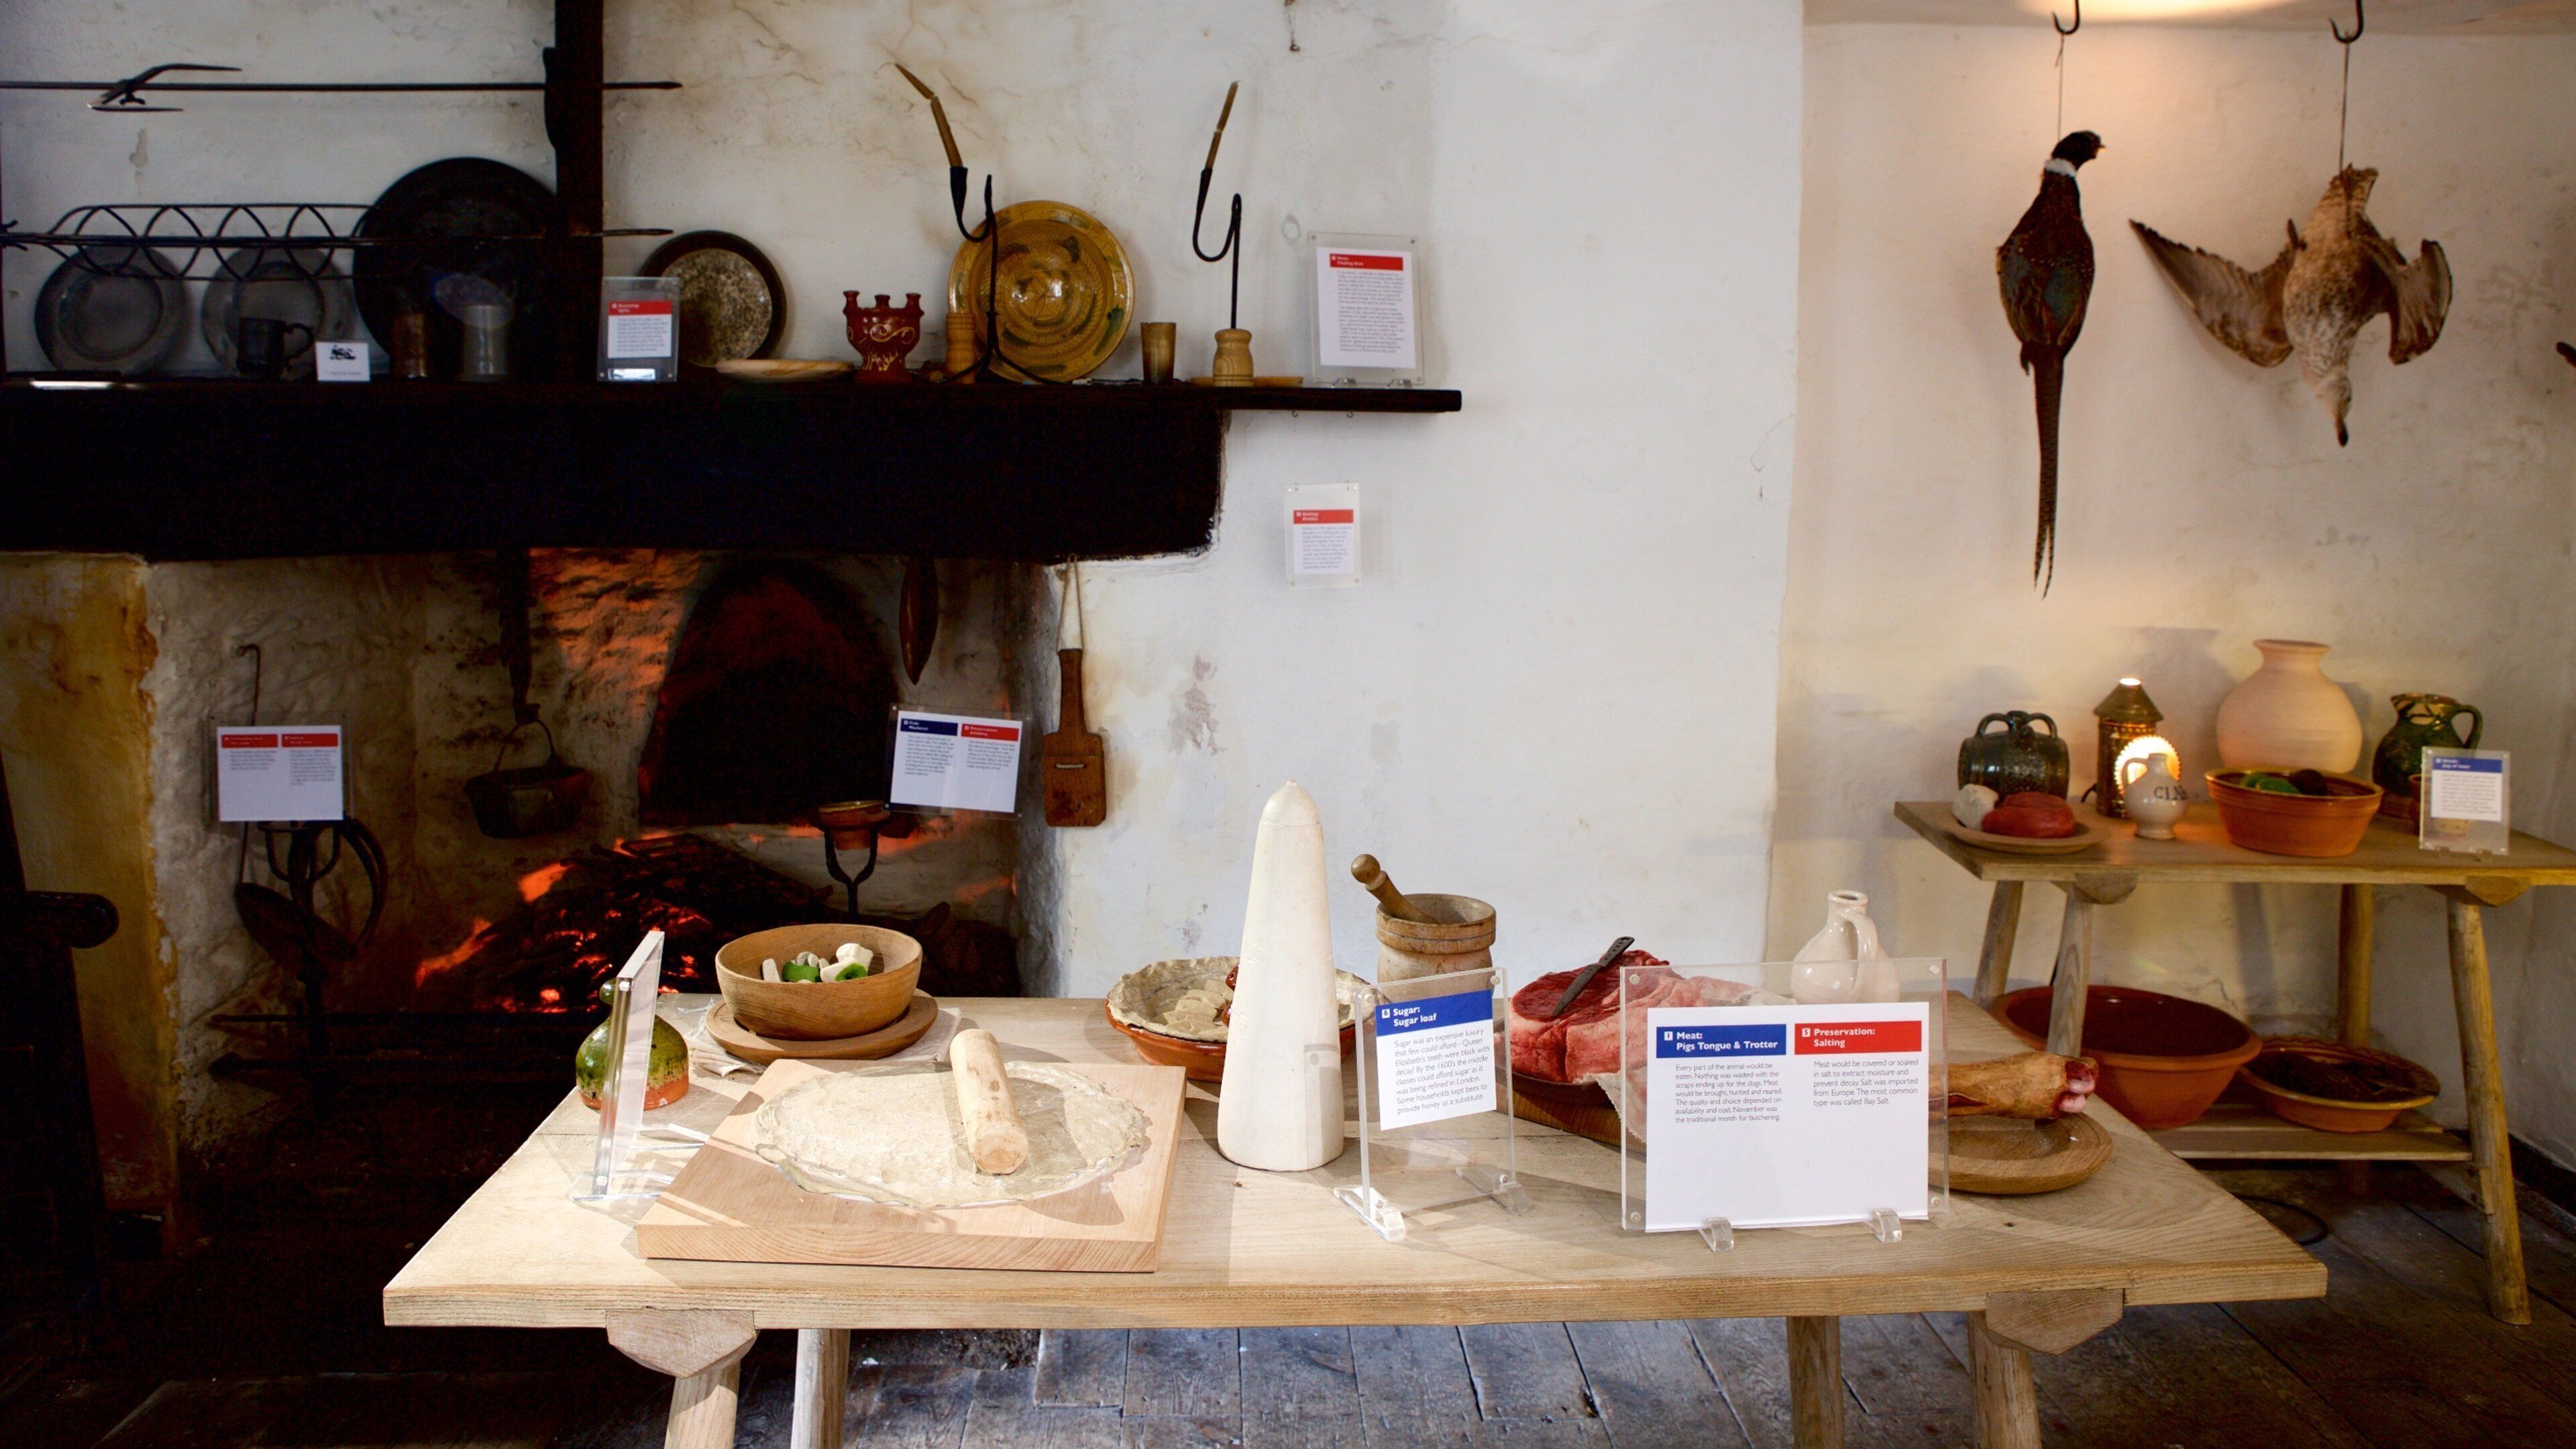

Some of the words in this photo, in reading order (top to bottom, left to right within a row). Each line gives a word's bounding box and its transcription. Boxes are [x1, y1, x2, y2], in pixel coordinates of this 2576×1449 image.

[1393, 1007, 1420, 1016] Sugar:
[1393, 1018, 1418, 1027] Sugar
[1420, 1013, 1437, 1022] loaf
[1814, 1028, 1875, 1036] Preservation:
[1435, 1032, 1464, 1042] expensive
[1462, 1038, 1483, 1046] Queen
[1814, 1039, 1845, 1048] Salting
[1676, 1042, 1695, 1052] Pigs
[1697, 1042, 1731, 1052] Tongue
[1693, 1064, 1706, 1072] part
[1436, 1071, 1453, 1079] afford
[1695, 1072, 1718, 1080] Nothing
[1428, 1081, 1448, 1089] refined
[1695, 1081, 1715, 1089] ending
[1813, 1079, 1838, 1088] prevent
[1888, 1077, 1919, 1086] imported
[1416, 1091, 1449, 1100] households
[1452, 1087, 1463, 1095] kept
[1466, 1084, 1479, 1093] bees
[1689, 1098, 1708, 1107] quality
[1743, 1096, 1772, 1105] depended
[1813, 1099, 1827, 1108] type
[1864, 1097, 1875, 1106] Bay
[1397, 1105, 1420, 1115] provide
[1422, 1102, 1440, 1110] honey
